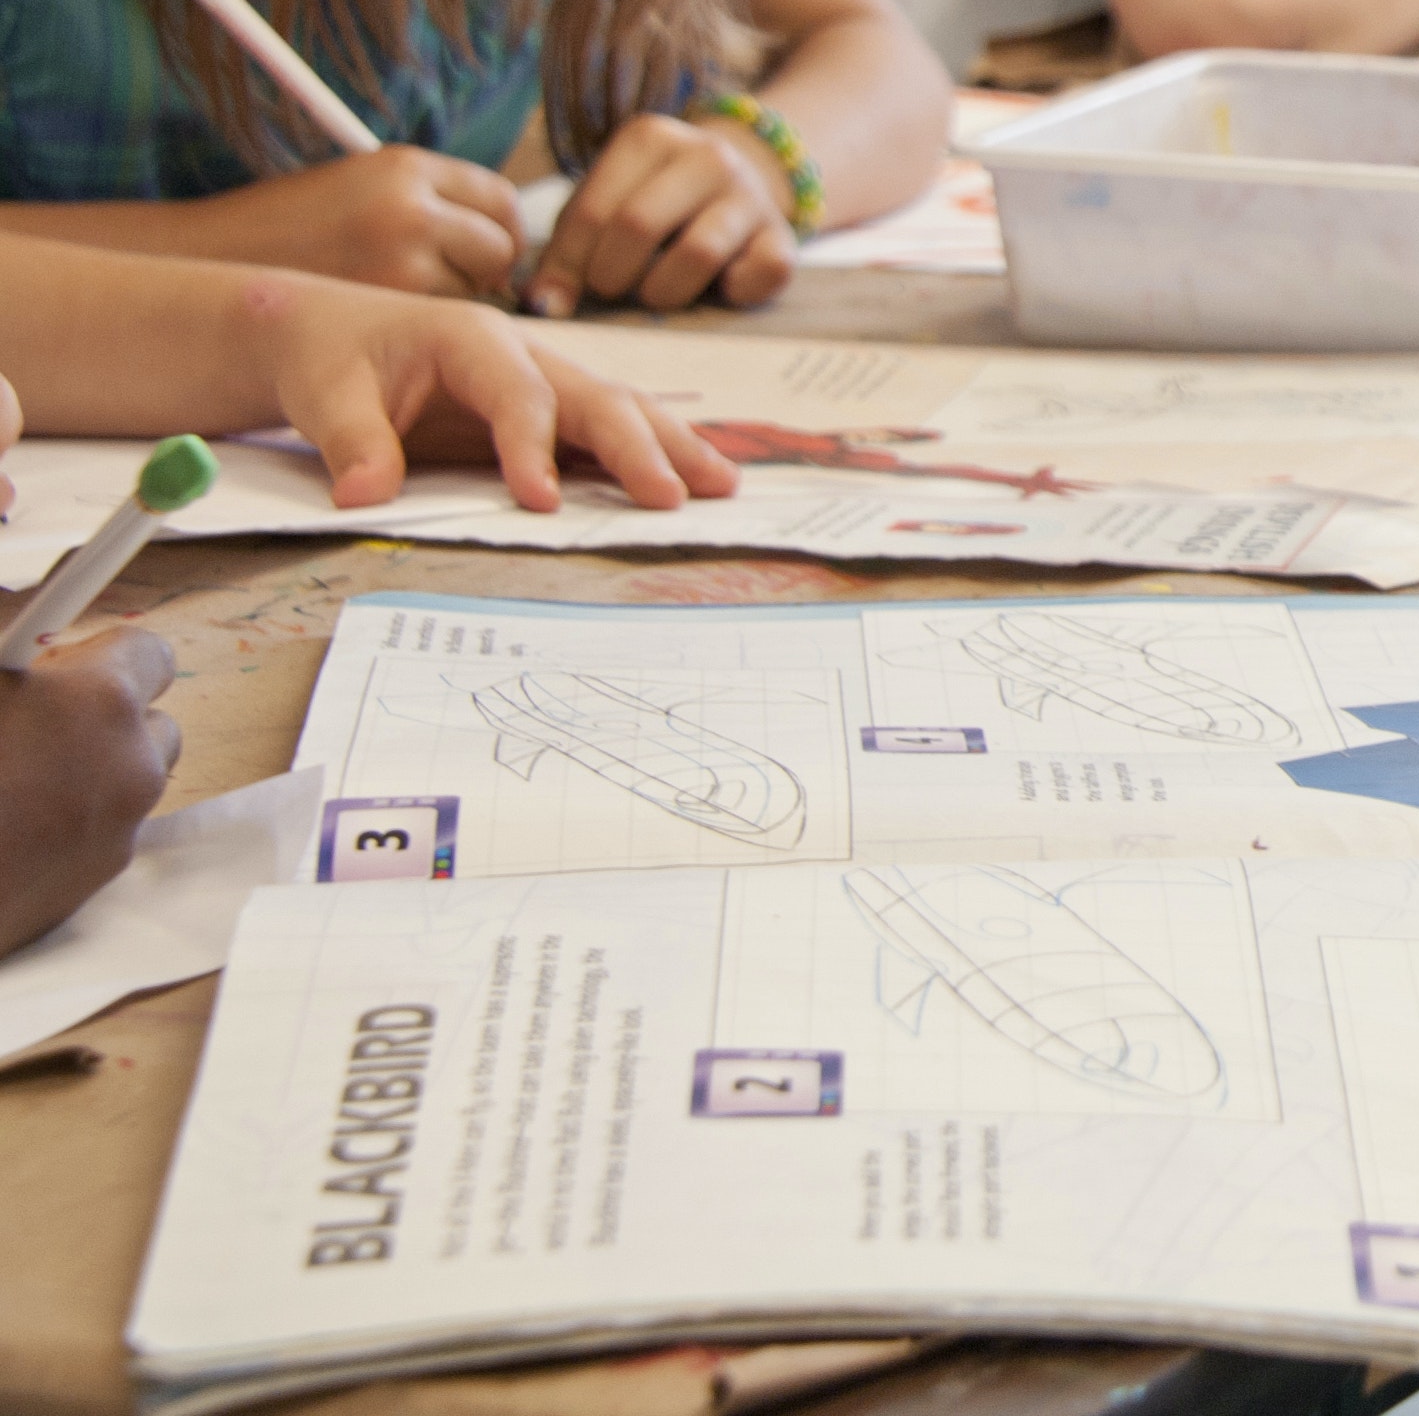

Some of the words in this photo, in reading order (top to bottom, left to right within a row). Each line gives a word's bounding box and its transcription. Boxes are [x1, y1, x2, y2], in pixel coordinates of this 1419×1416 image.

[355, 829, 410, 851] 3
[732, 1075, 793, 1093] 2
[306, 1002, 438, 1269] BLACKBIRD
